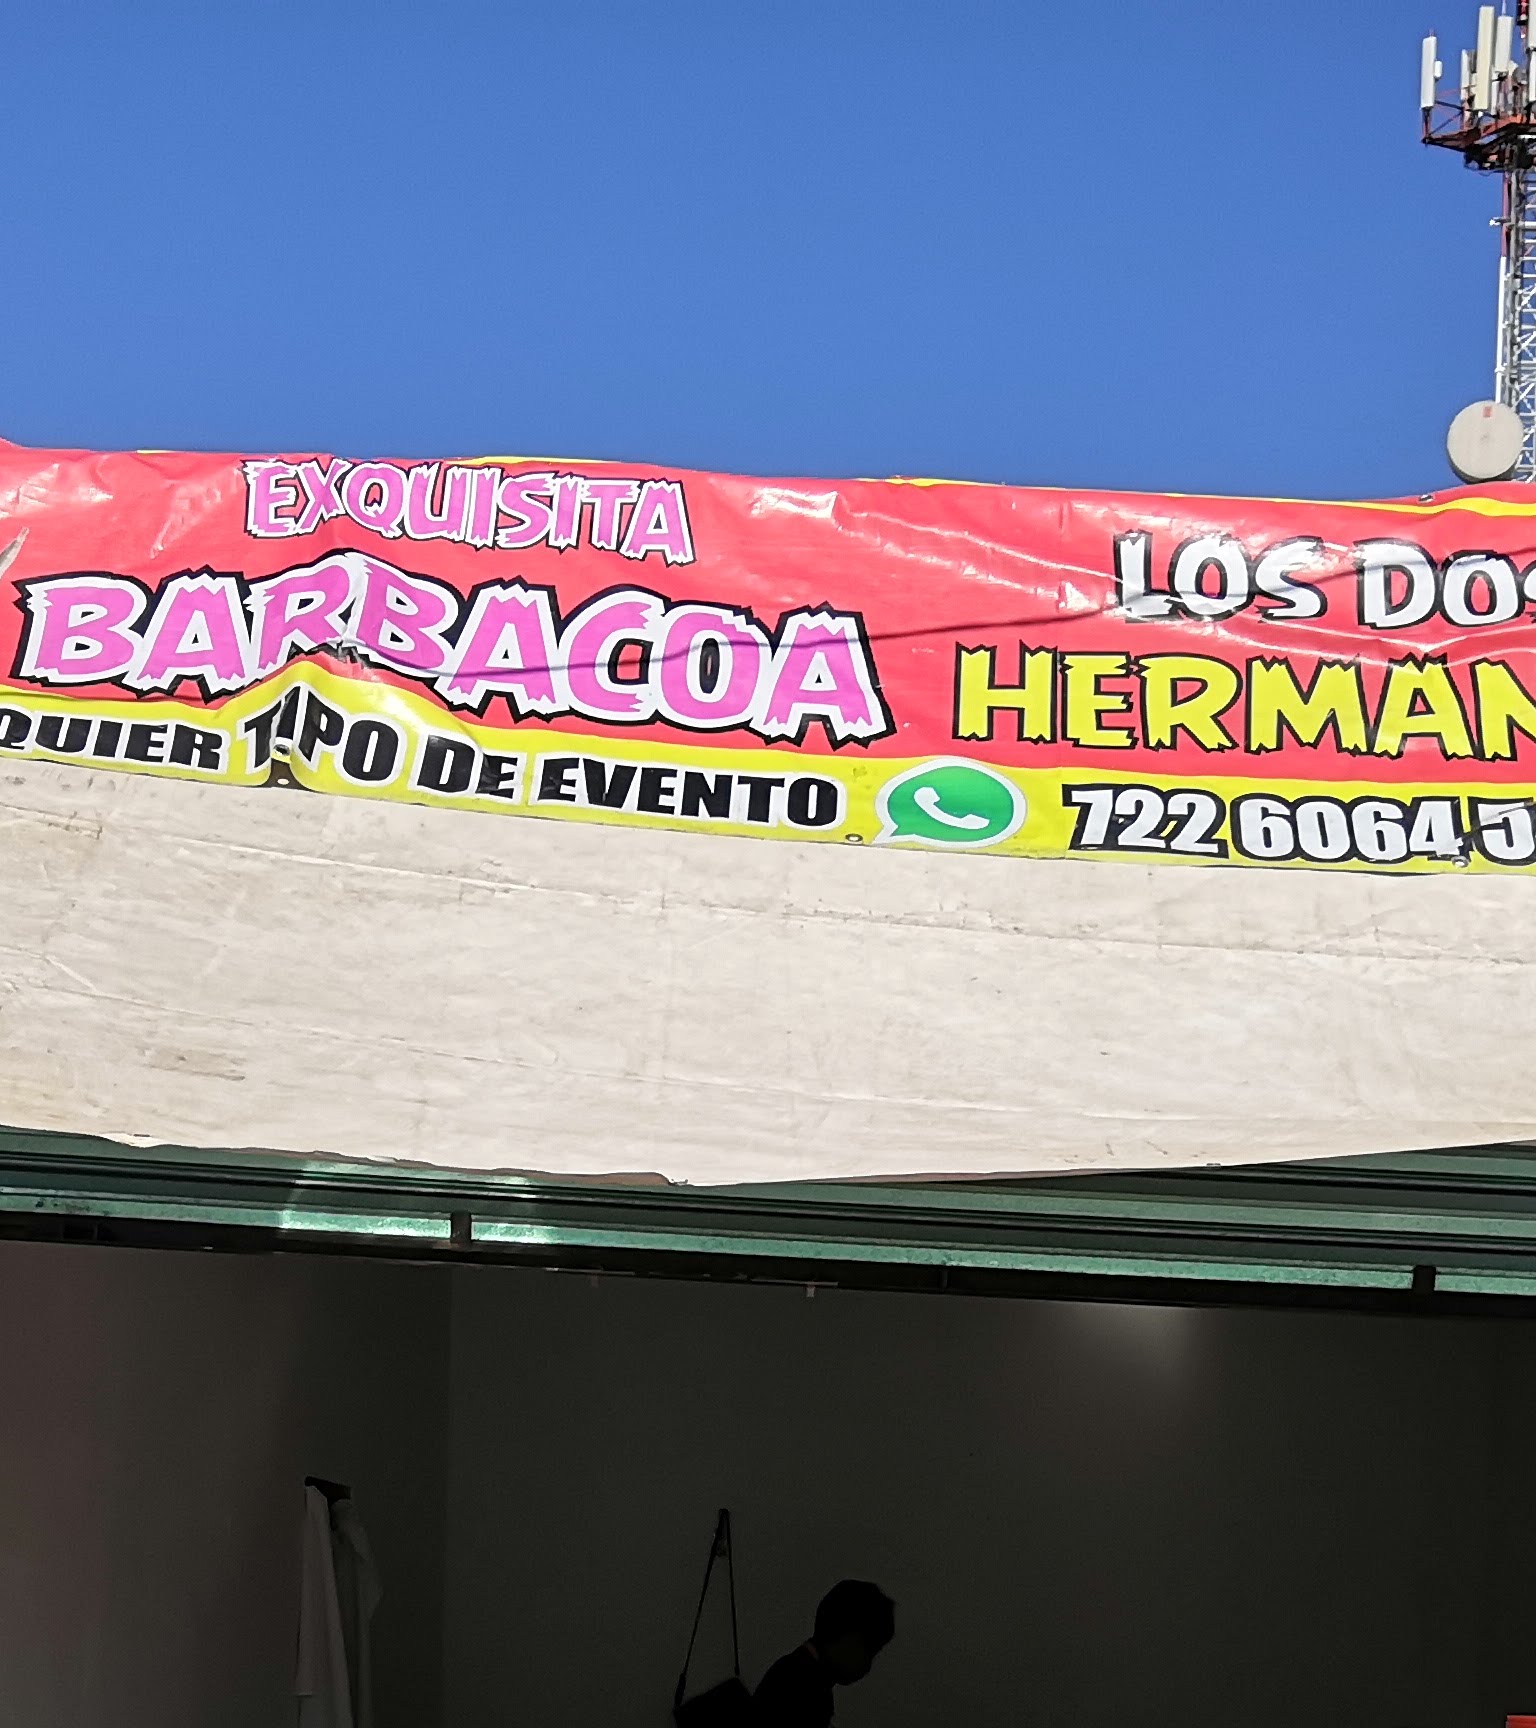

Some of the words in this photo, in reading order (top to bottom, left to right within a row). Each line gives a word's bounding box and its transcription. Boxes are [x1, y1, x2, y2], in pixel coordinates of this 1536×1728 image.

[241, 458, 695, 567] EXQUISITA
[1112, 529, 1330, 625] LOS
[14, 550, 896, 748] BARBACOA
[242, 685, 400, 783] TIPO
[418, 734, 520, 800] DE
[538, 757, 840, 829] EVENTO
